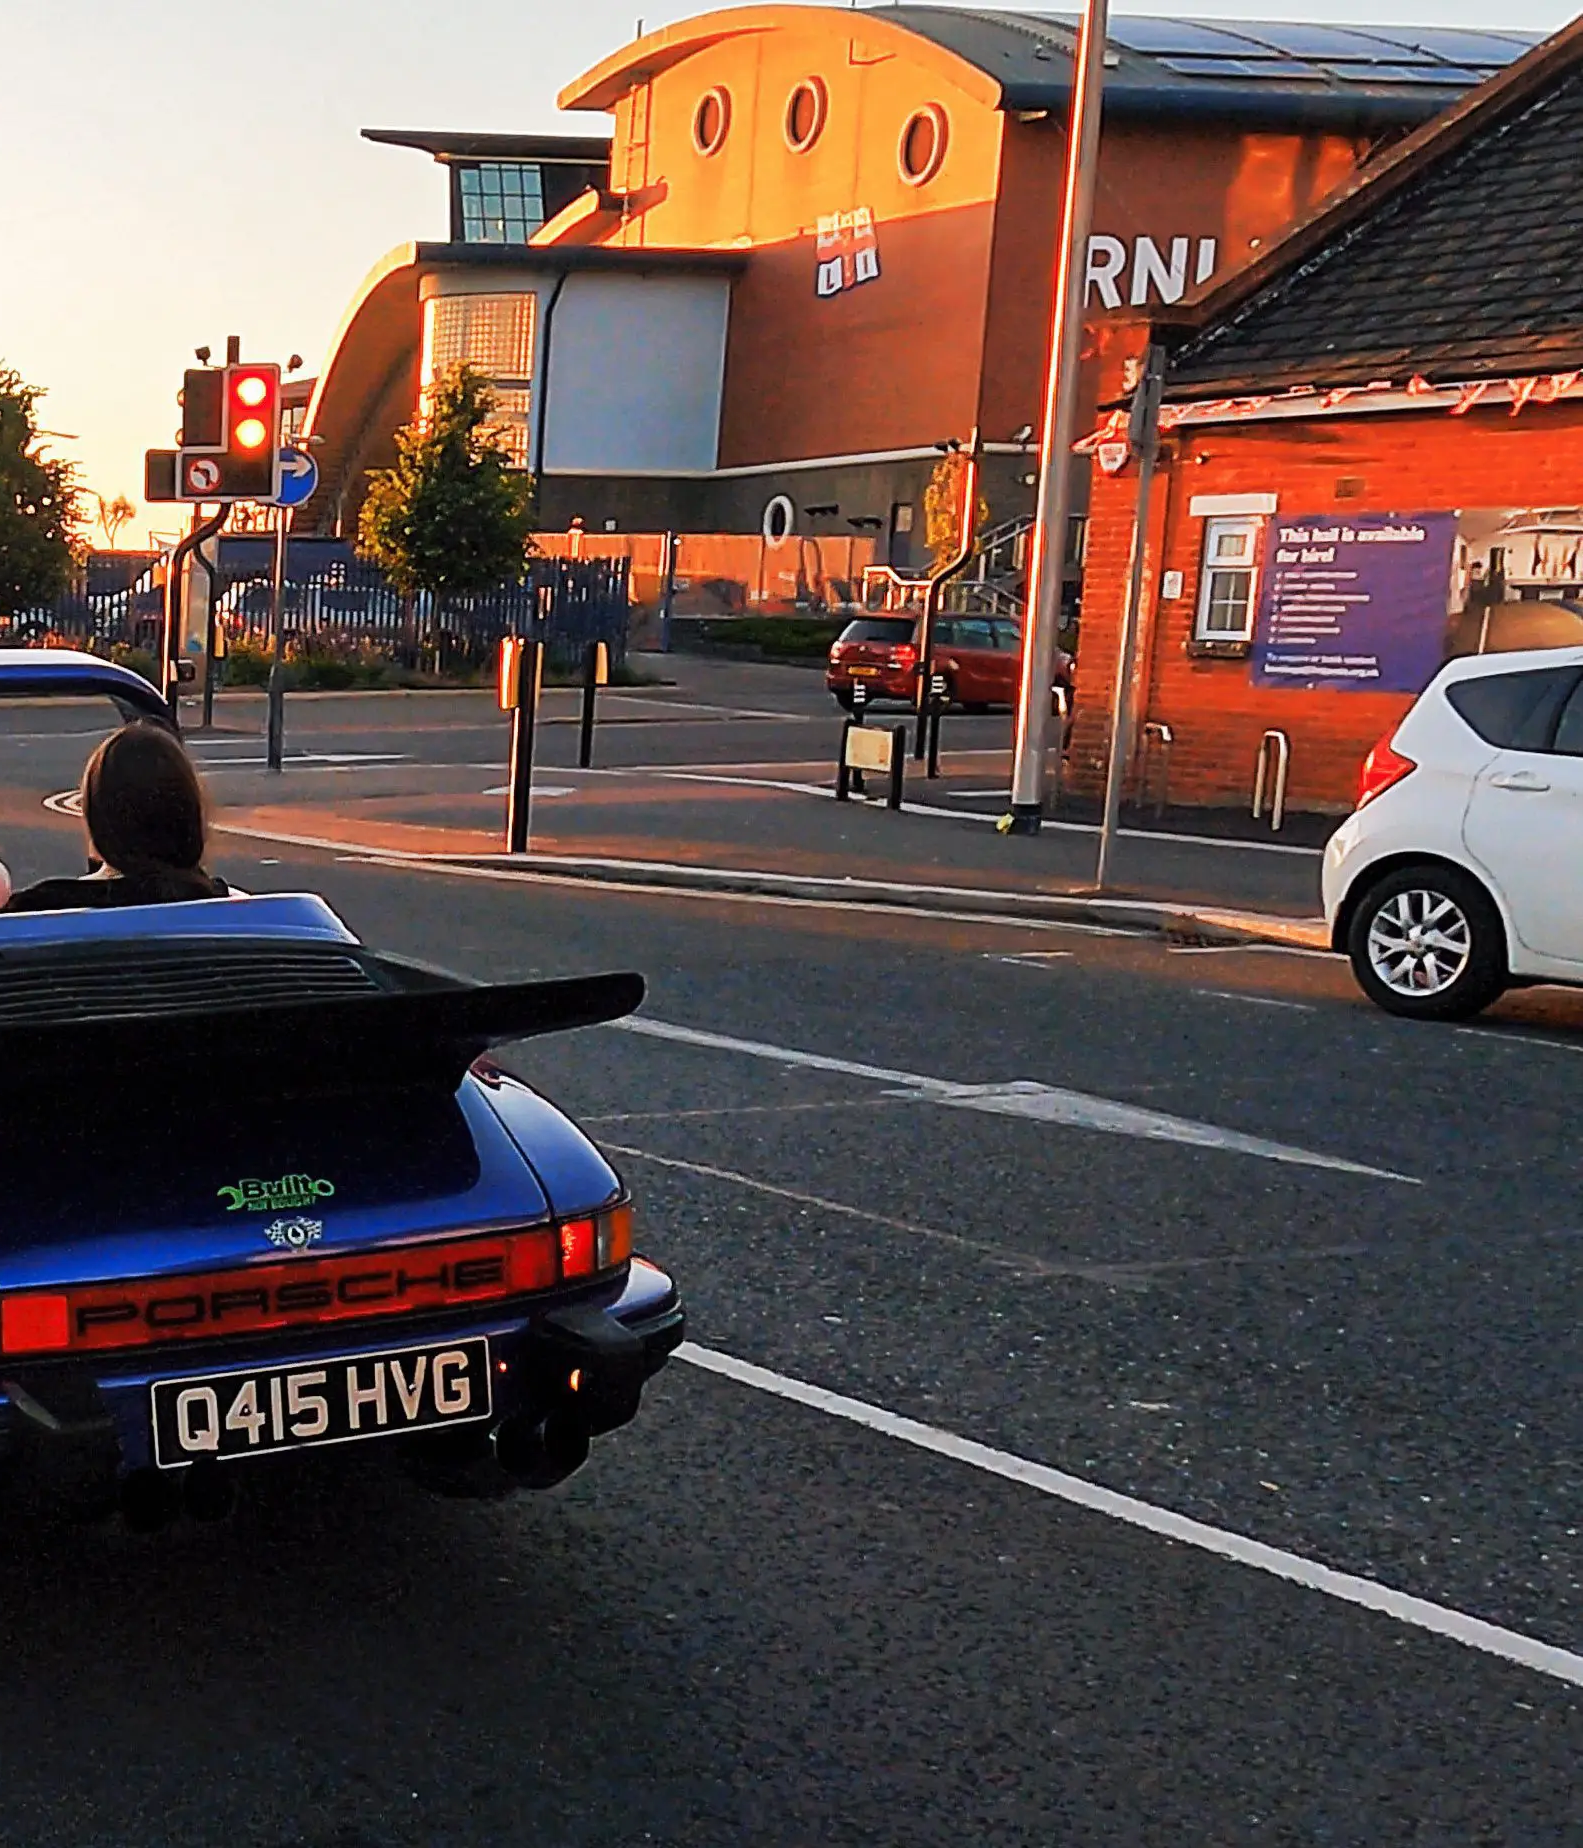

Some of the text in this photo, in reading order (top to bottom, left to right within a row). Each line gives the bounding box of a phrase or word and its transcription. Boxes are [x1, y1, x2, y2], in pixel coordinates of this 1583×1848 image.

[1280, 527, 1310, 543] This
[1341, 526, 1355, 542] is
[1356, 526, 1425, 542] available
[238, 1174, 313, 1198] Built
[75, 1256, 506, 1336] PORSCHE
[176, 1352, 471, 1452] Q415 HVG
